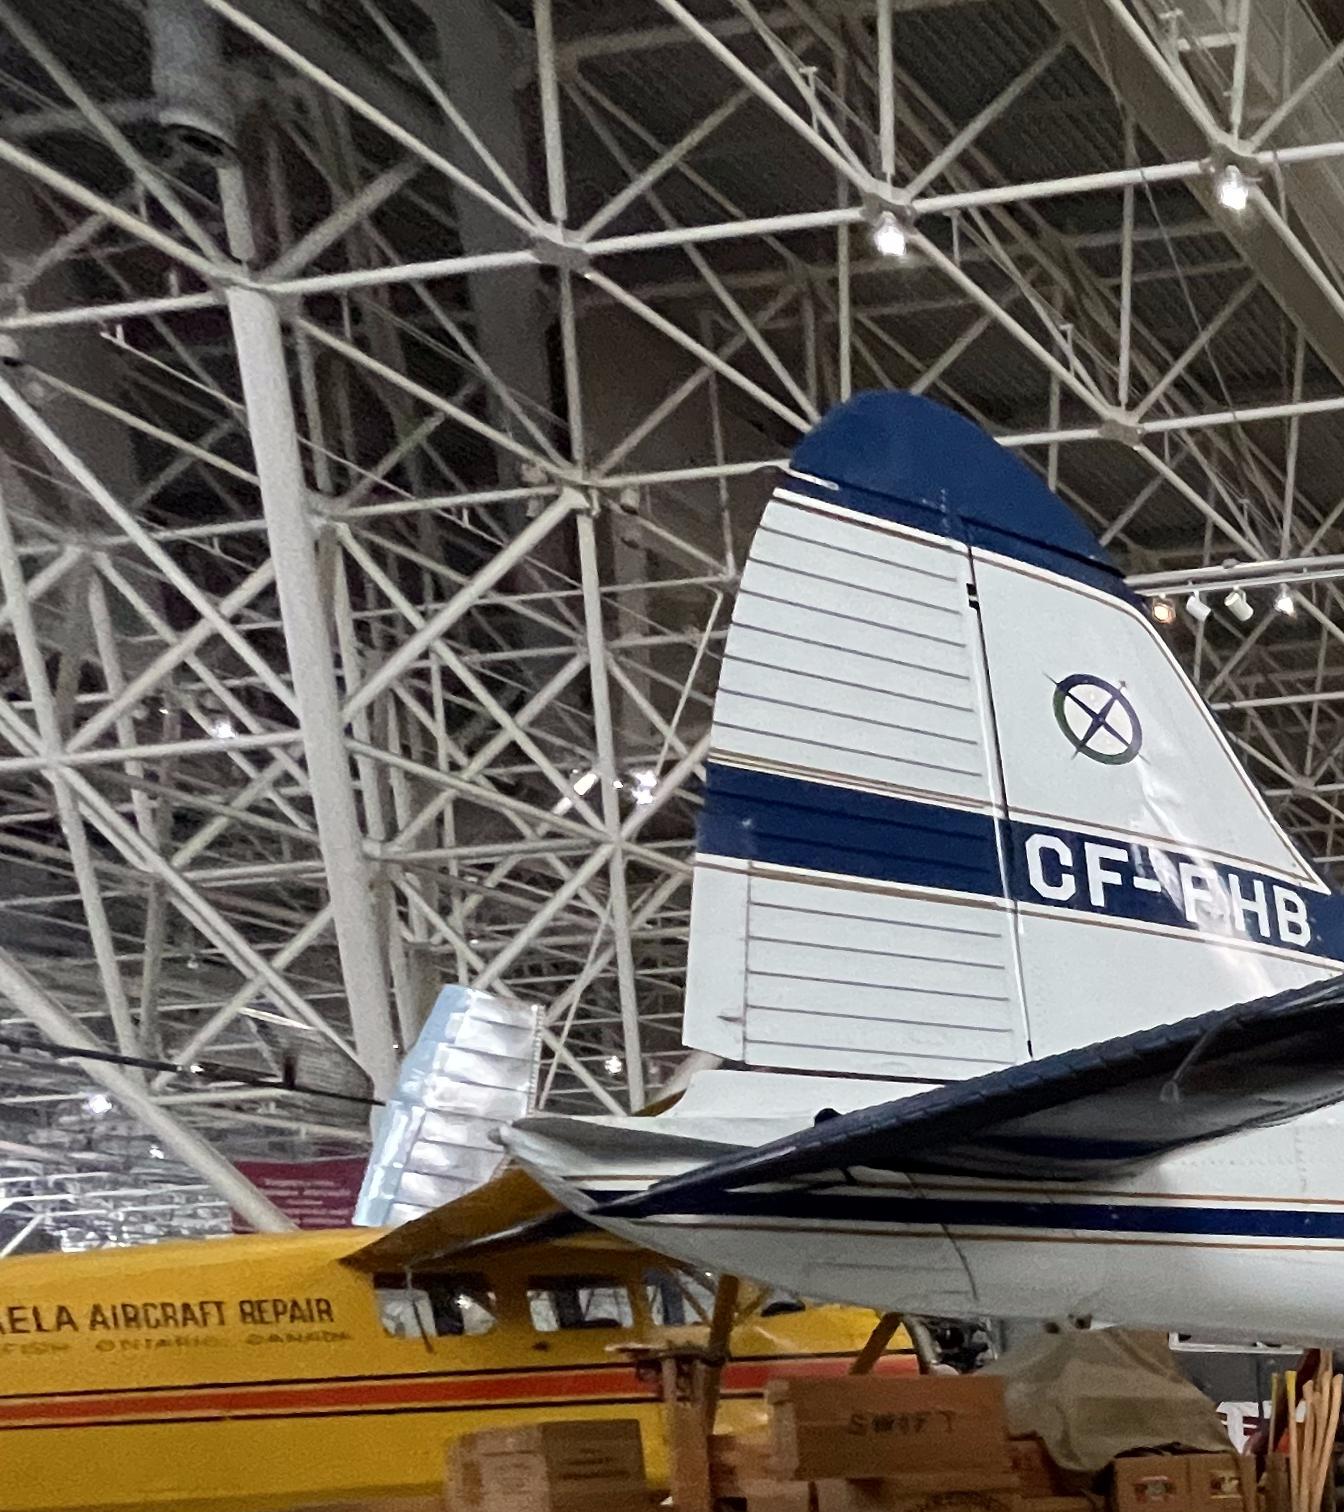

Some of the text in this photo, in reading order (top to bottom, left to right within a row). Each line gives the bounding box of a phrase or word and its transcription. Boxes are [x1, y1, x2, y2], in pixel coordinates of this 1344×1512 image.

[0, 1298, 334, 1335] ELA AIRCRAFT REPAIR
